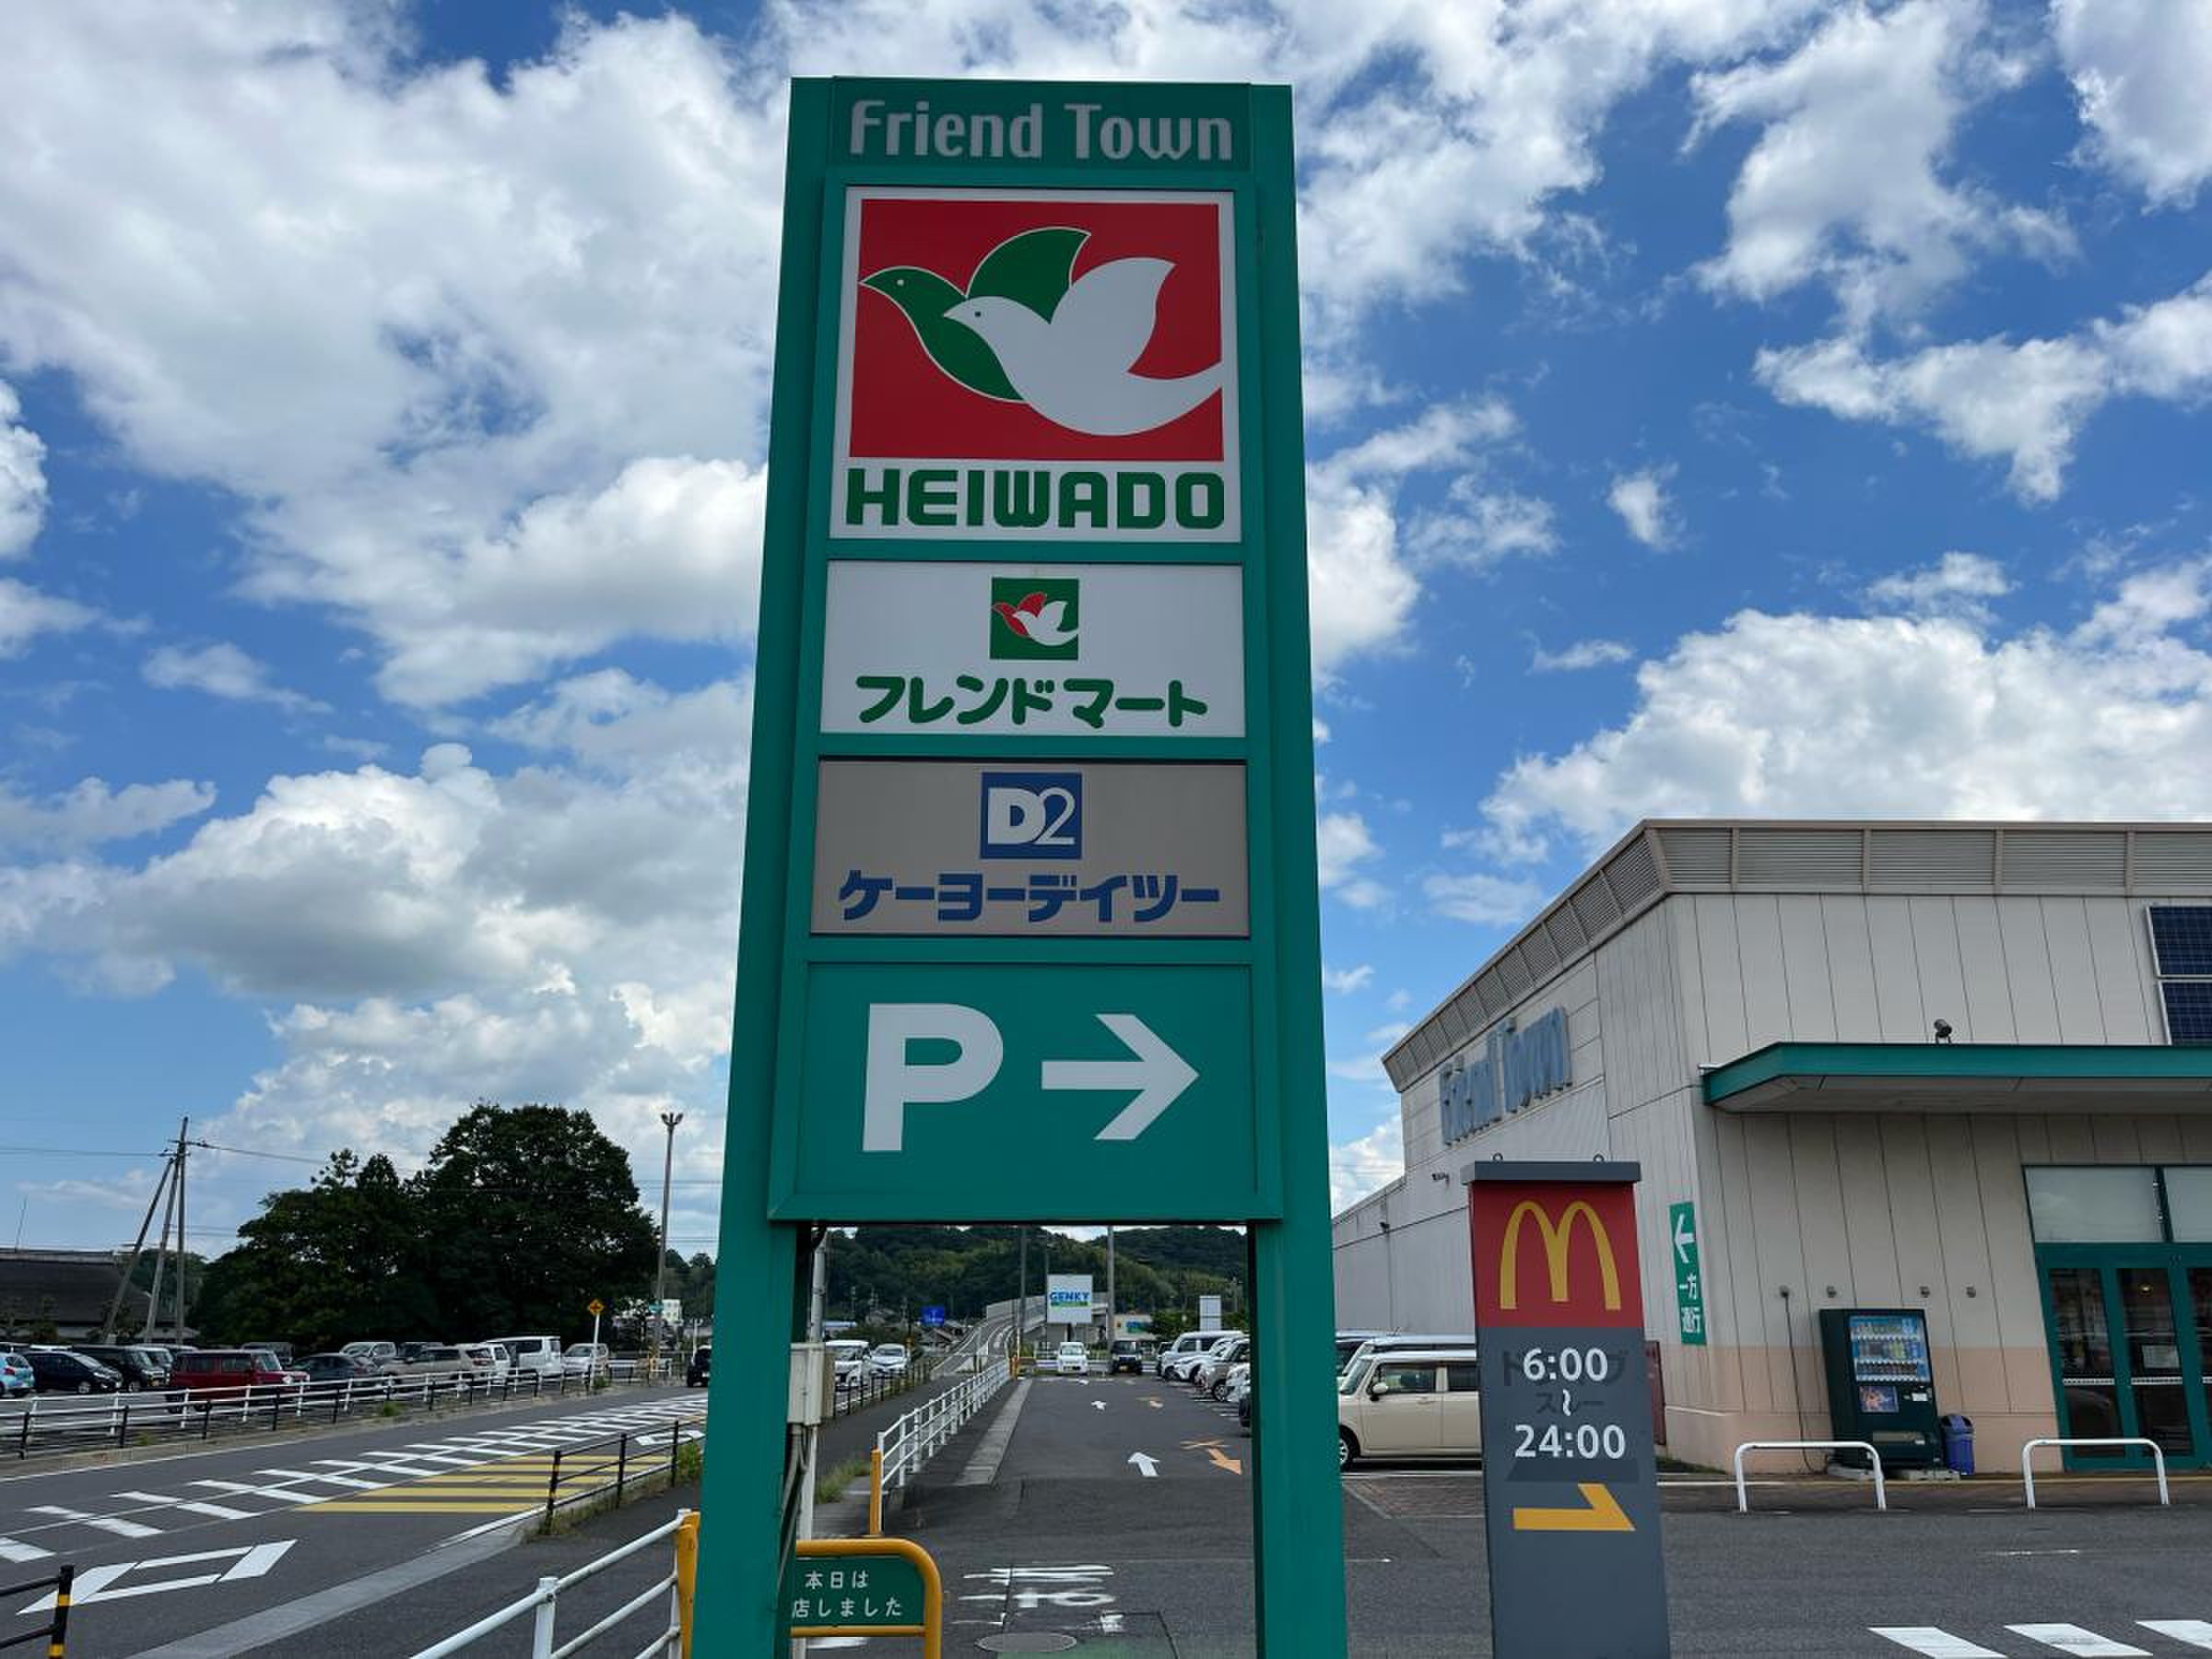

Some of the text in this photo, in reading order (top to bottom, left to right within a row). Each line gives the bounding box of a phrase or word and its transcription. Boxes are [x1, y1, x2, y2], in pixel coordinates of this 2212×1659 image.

[850, 100, 1233, 161] Friend Town
[845, 468, 1225, 530] HEIWADO
[855, 675, 1208, 729] フレンドマート
[987, 786, 1077, 846] D2
[839, 870, 1220, 923] ケーヨーデイツー
[862, 1002, 1004, 1151] P
[1049, 1290, 1090, 1302] GENKY
[1523, 1347, 1608, 1382] 6:00
[1514, 1424, 1626, 1460] 24:00
[805, 1570, 870, 1590] 本日は
